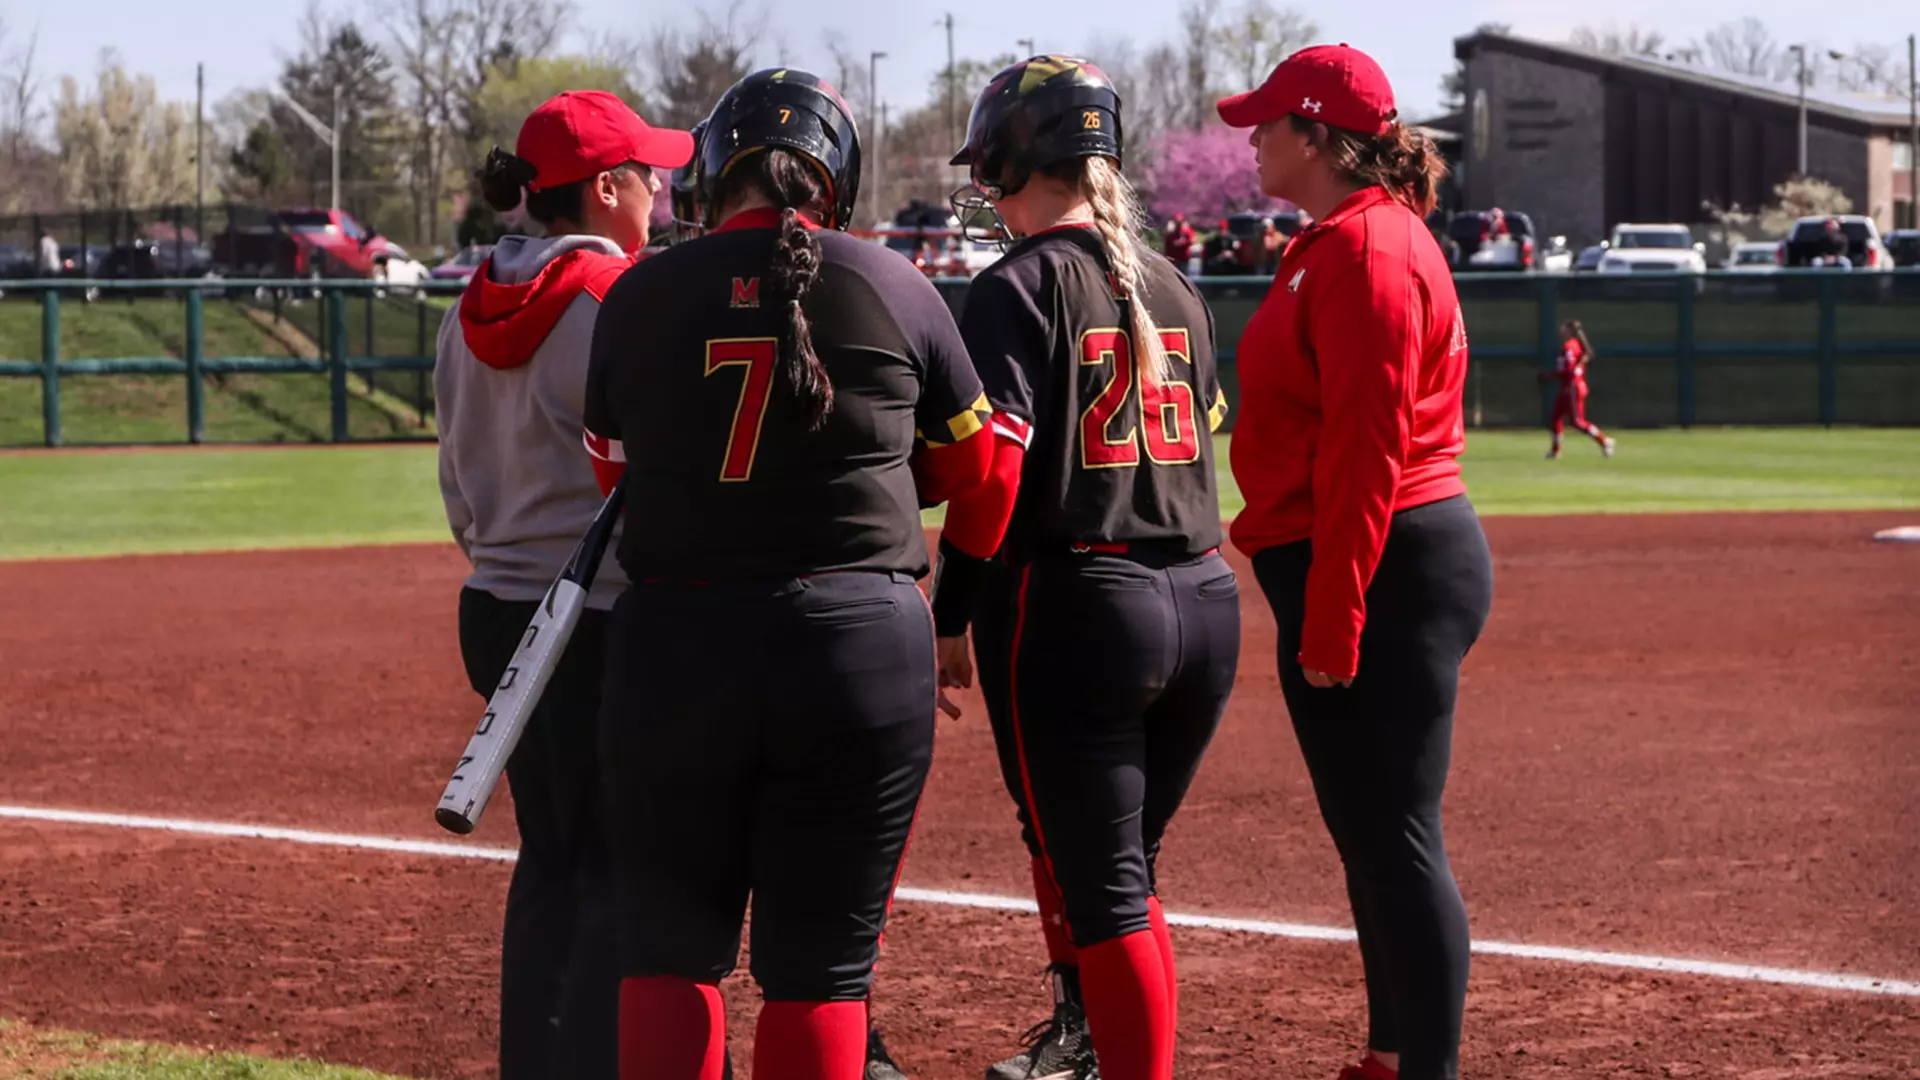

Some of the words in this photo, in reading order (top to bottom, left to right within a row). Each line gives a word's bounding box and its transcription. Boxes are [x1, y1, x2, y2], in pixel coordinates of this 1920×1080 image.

[779, 109, 791, 124] 7
[1083, 111, 1100, 129] 26
[730, 276, 760, 304] M
[704, 337, 778, 482] 7
[1080, 327, 1199, 469] 26
